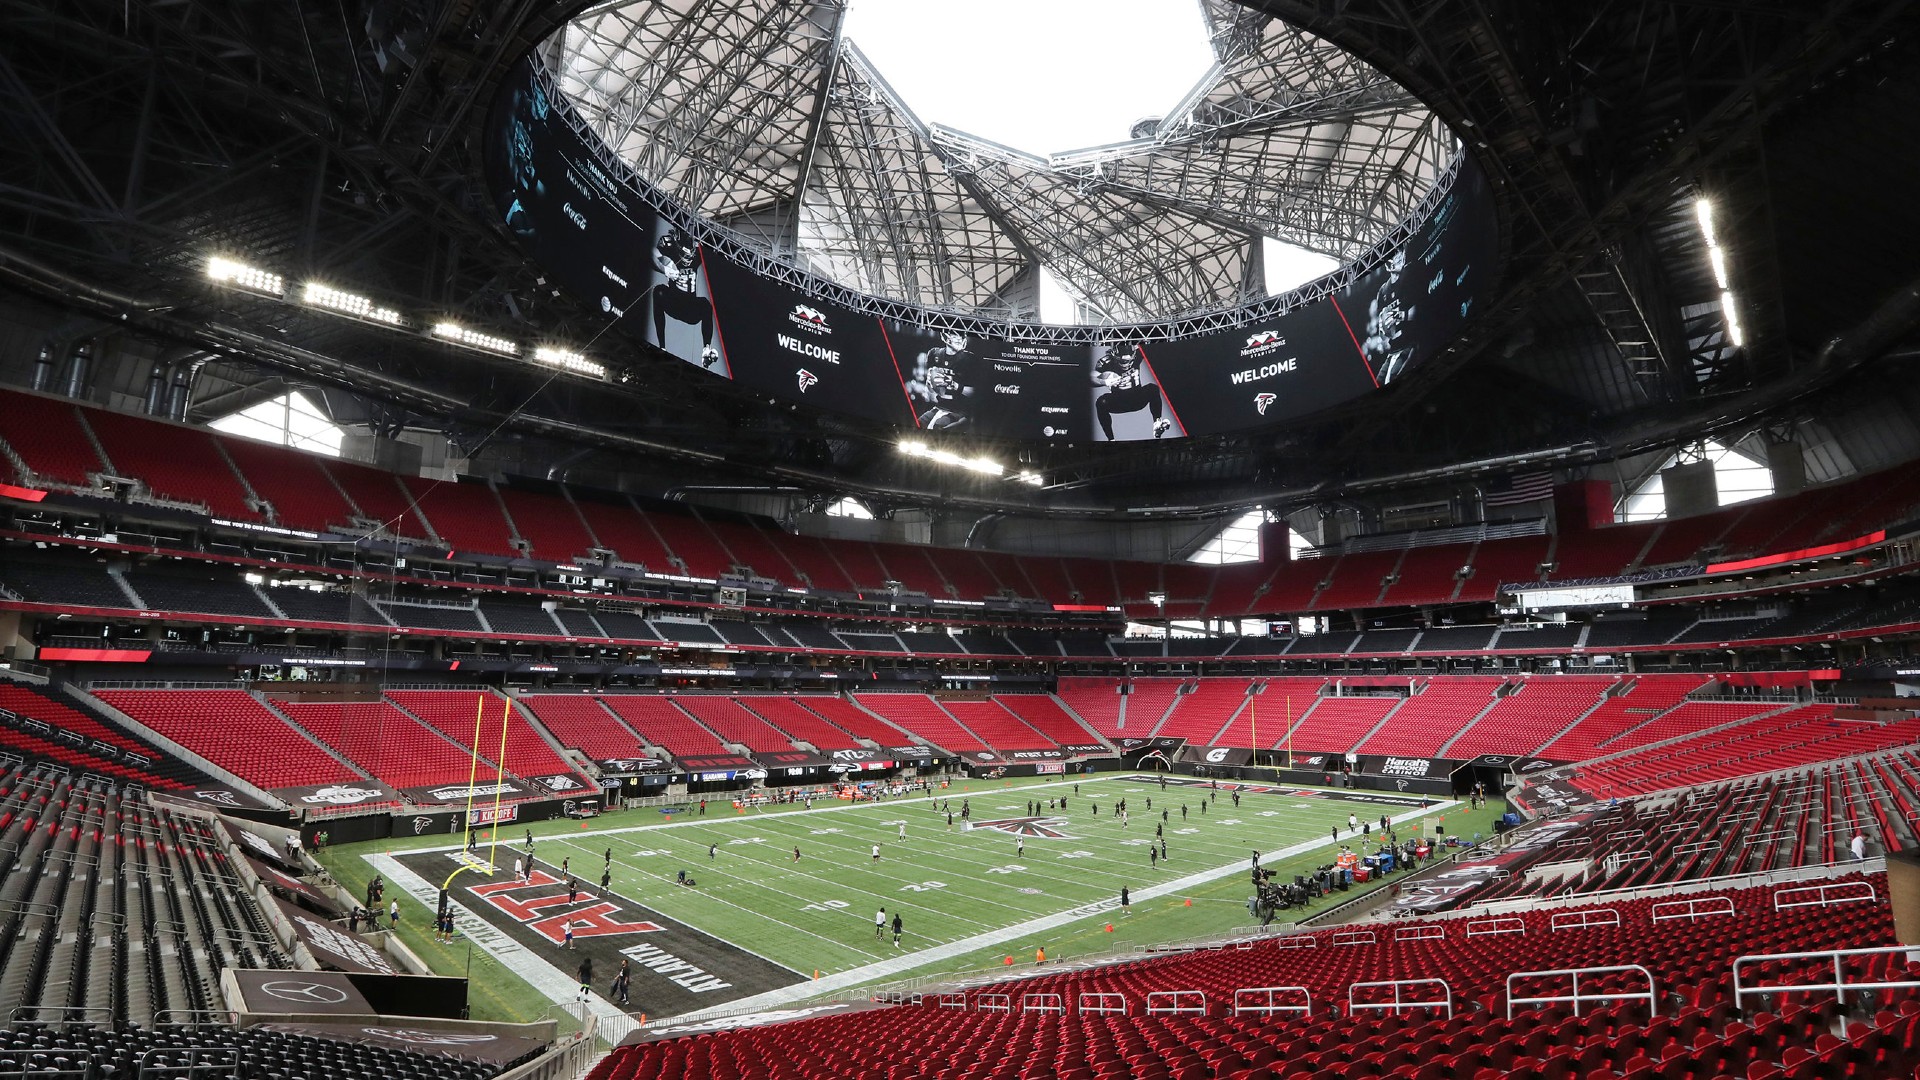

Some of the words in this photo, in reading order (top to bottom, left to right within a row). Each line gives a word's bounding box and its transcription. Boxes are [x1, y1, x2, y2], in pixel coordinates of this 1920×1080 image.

[587, 159, 606, 184] THANK
[606, 178, 618, 195] YOU
[788, 312, 832, 335] Mercedes-Benz
[797, 324, 823, 336] STADIUM
[777, 332, 840, 365] WELCOME
[1014, 346, 1035, 354] THANK
[1240, 339, 1286, 357] Mercedes-Benz
[1250, 348, 1277, 359] STADIUM
[994, 363, 1022, 373] Novelis
[1231, 357, 1297, 385] WELCOME
[211, 518, 231, 527] THANK
[264, 526, 291, 534] FOUNDING
[292, 530, 317, 539] PARTNERS
[683, 757, 751, 767] RISE
[774, 754, 809, 762] UP
[1385, 757, 1430, 767] Harrah's
[630, 777, 637, 785] 40
[305, 790, 379, 802] LOTTERY
[482, 808, 512, 821] KICOFF
[898, 880, 947, 893] 20
[799, 900, 850, 912] 10
[618, 942, 733, 993] ATLANTA
